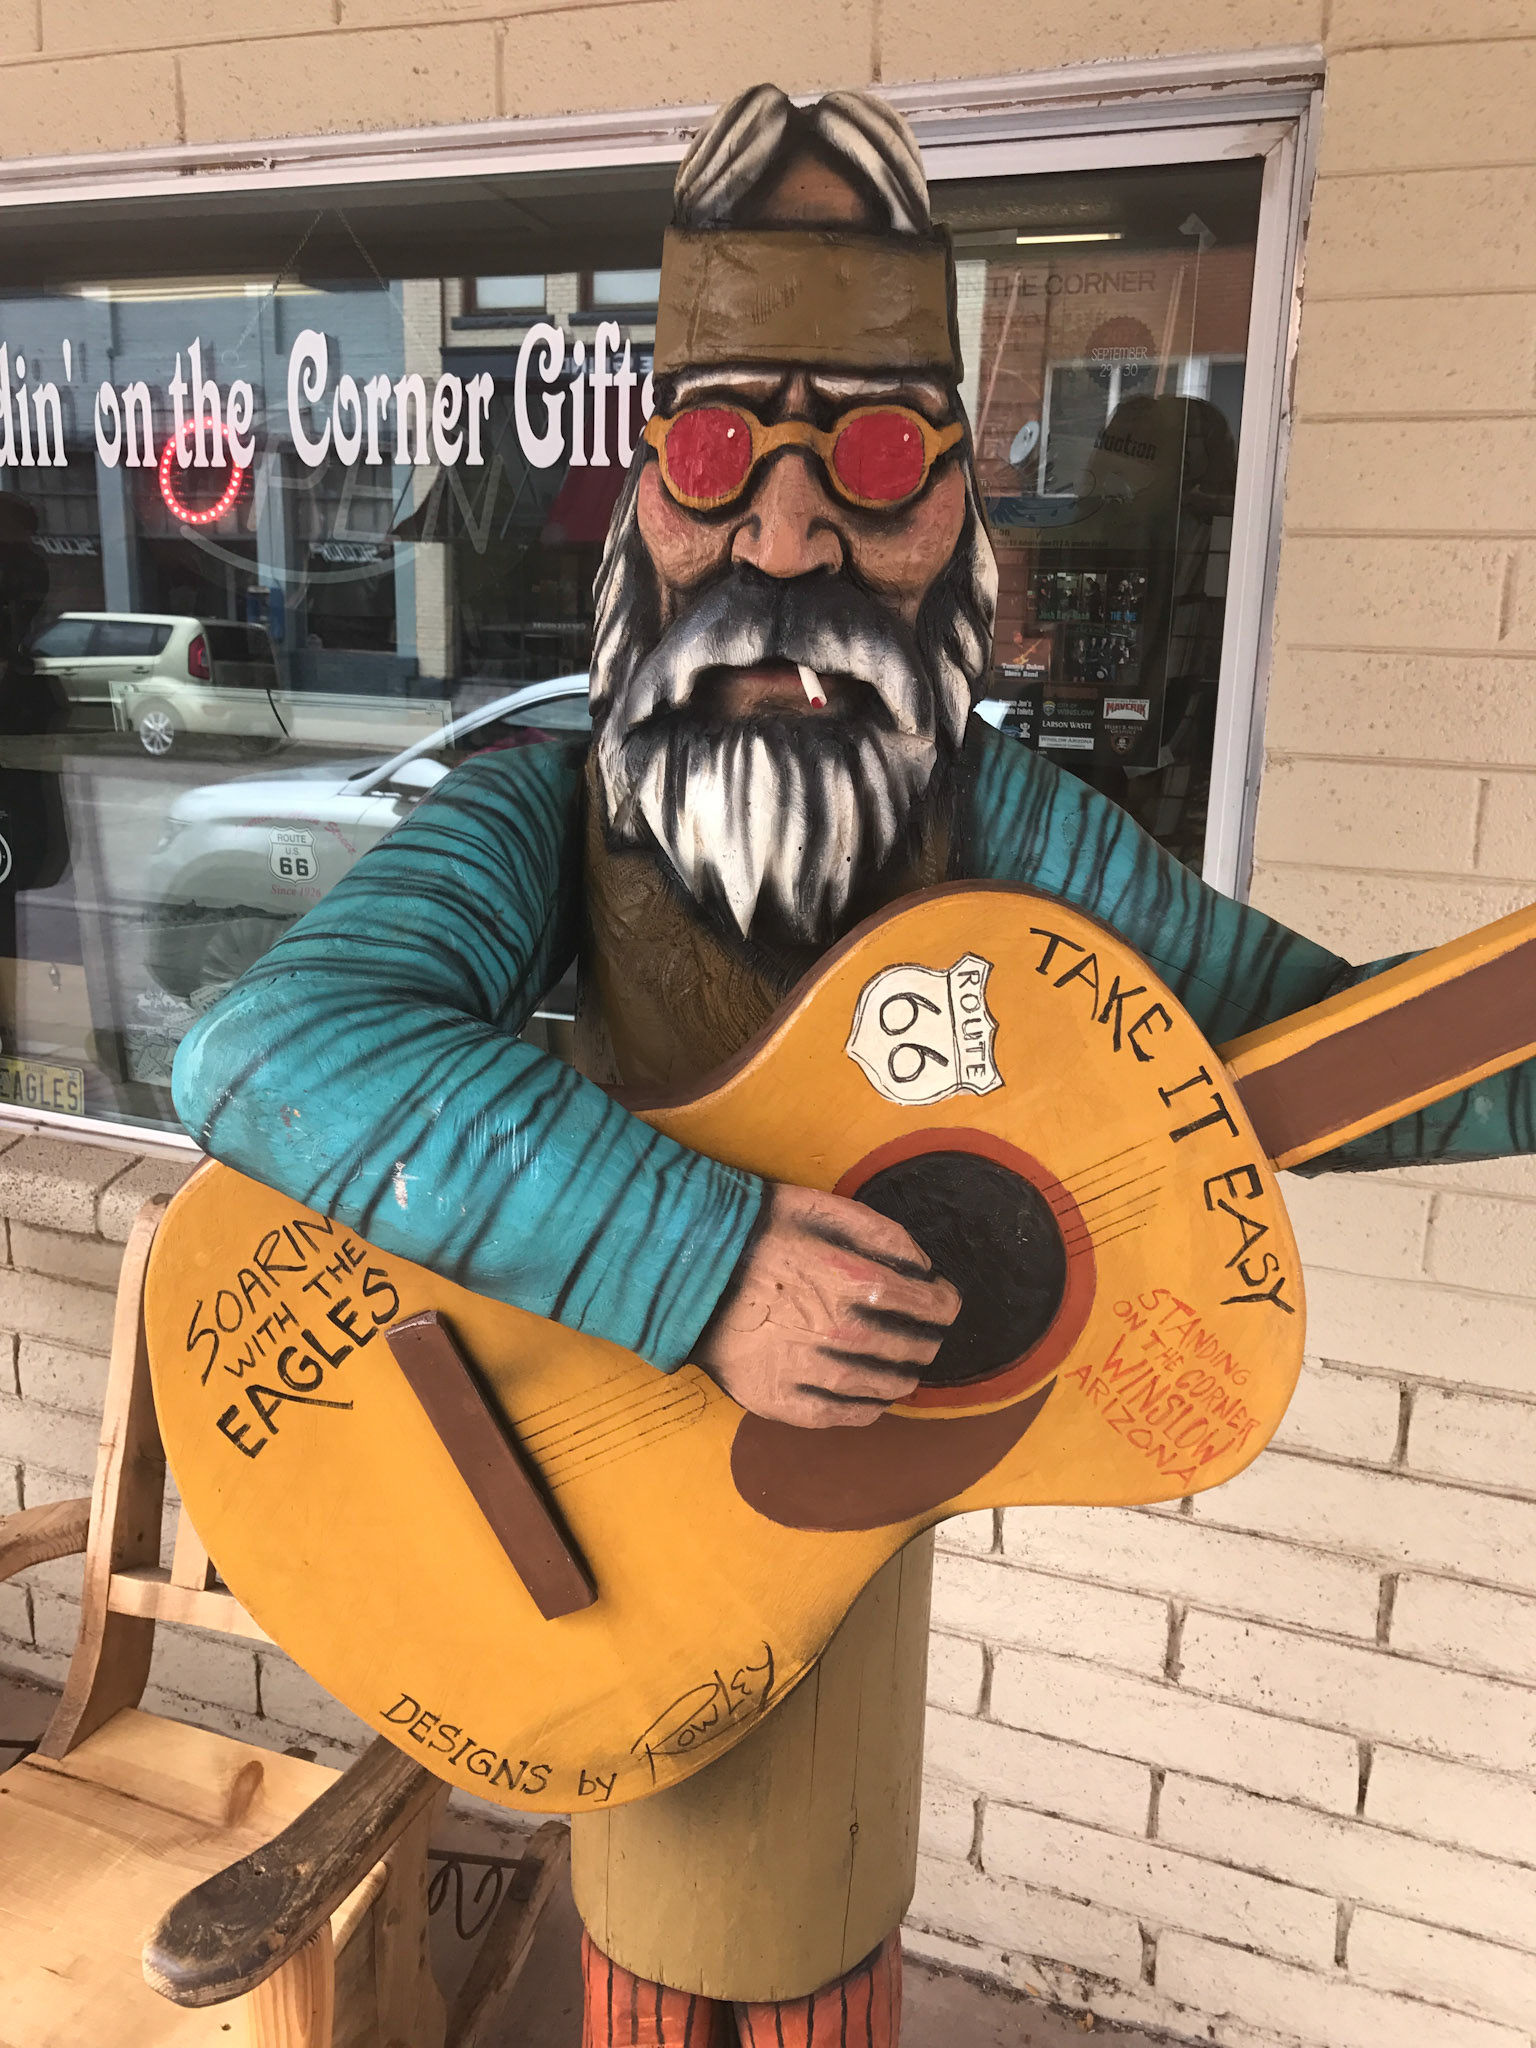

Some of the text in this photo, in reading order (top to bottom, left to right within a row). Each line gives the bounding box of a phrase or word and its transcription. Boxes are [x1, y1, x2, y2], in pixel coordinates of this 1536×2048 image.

[1045, 271, 1157, 296] CORNER
[1091, 346, 1149, 361] SEPTEMBER
[1122, 362, 1139, 377] 30
[94, 378, 159, 469] on
[167, 336, 256, 470] the
[287, 328, 496, 469] Corner
[1042, 720, 1093, 730] LARSON WASTE
[1056, 708, 1096, 717] WINSLOW
[1105, 702, 1147, 718] MAVERIK
[277, 833, 307, 844] ROUTE
[279, 856, 310, 877] 66
[285, 847, 301, 856] U.S.
[271, 884, 322, 898] Since 1926
[878, 991, 949, 1083] 66
[956, 969, 988, 1080] ROUTE
[0, 1068, 78, 1111] EAGLES
[1029, 927, 1296, 1315] TAKE IT EASY
[223, 1238, 367, 1379] WITH THE
[1137, 1288, 1252, 1386] STANDING
[215, 1267, 400, 1459] EAGLES
[1112, 1300, 1261, 1453] ON THE CORNER
[1064, 1364, 1199, 1490] ARIZONA
[1101, 1333, 1236, 1466] WINSLOW
[379, 1693, 554, 1795] DESIGNS
[578, 1769, 618, 1803] by
